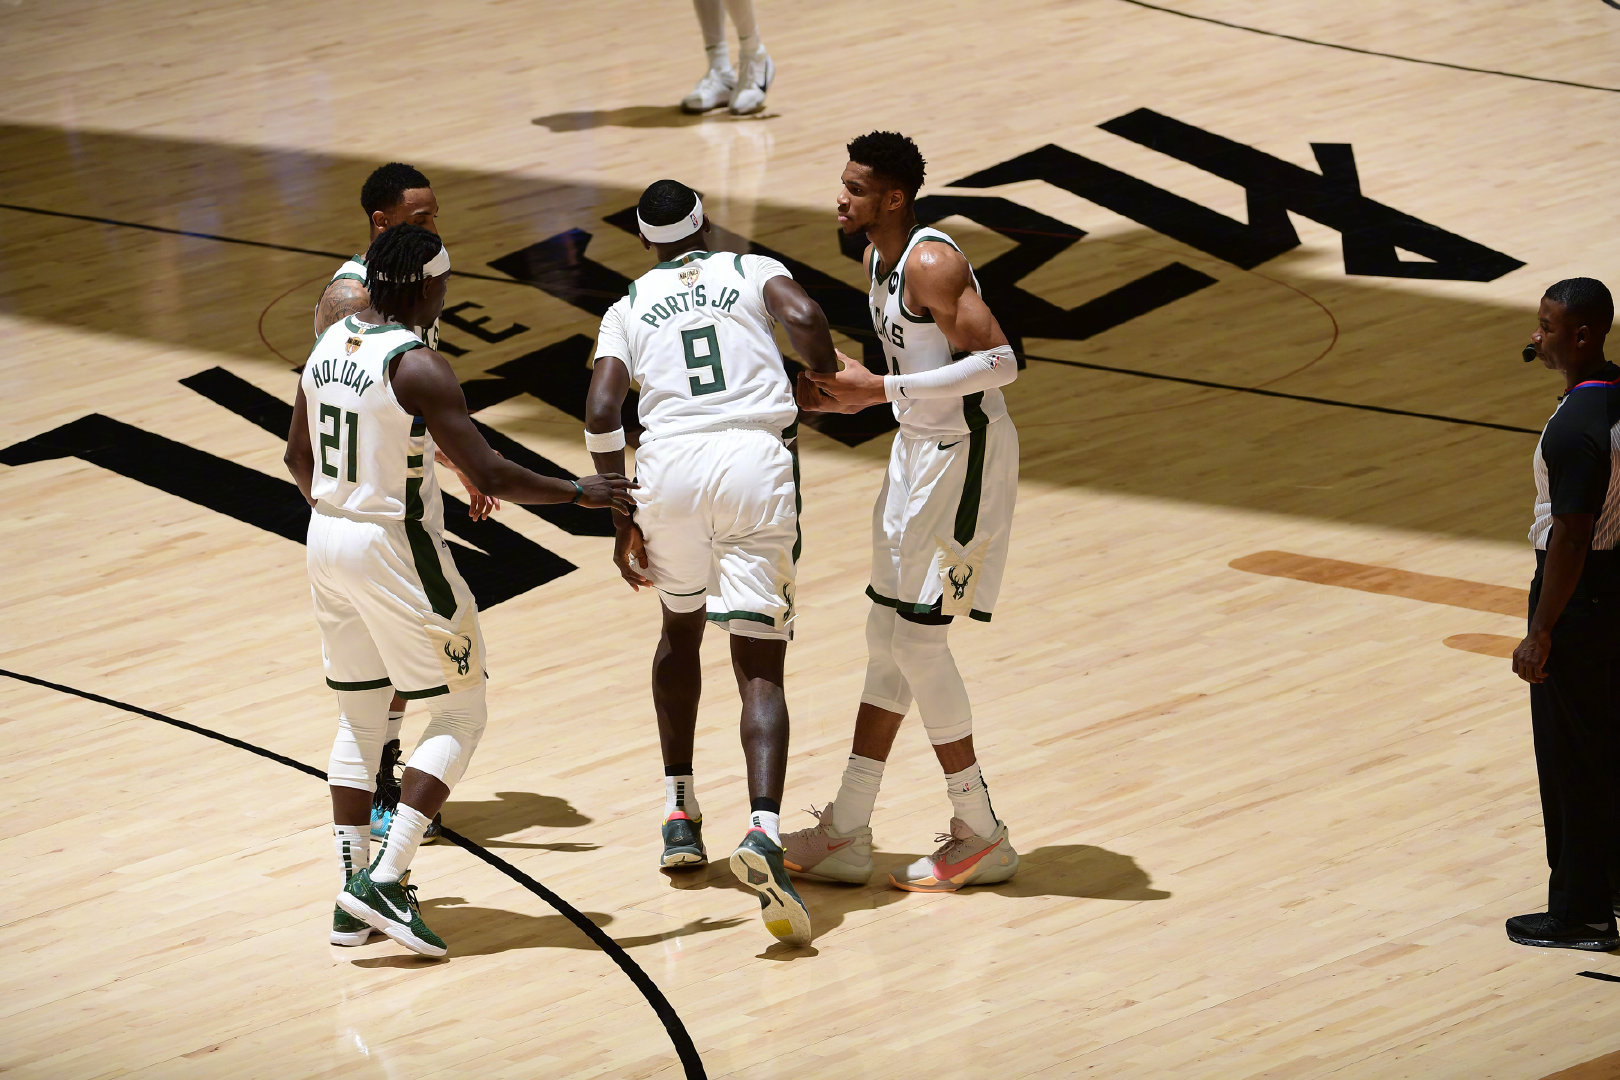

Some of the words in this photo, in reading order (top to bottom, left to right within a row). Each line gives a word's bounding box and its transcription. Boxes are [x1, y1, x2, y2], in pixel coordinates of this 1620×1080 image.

[641, 285, 707, 329] PORTIS
[711, 286, 740, 313] JR
[873, 307, 905, 349] CKS
[311, 358, 375, 397] HOLIDAY
[680, 324, 727, 397] 9
[319, 402, 360, 484] 21
